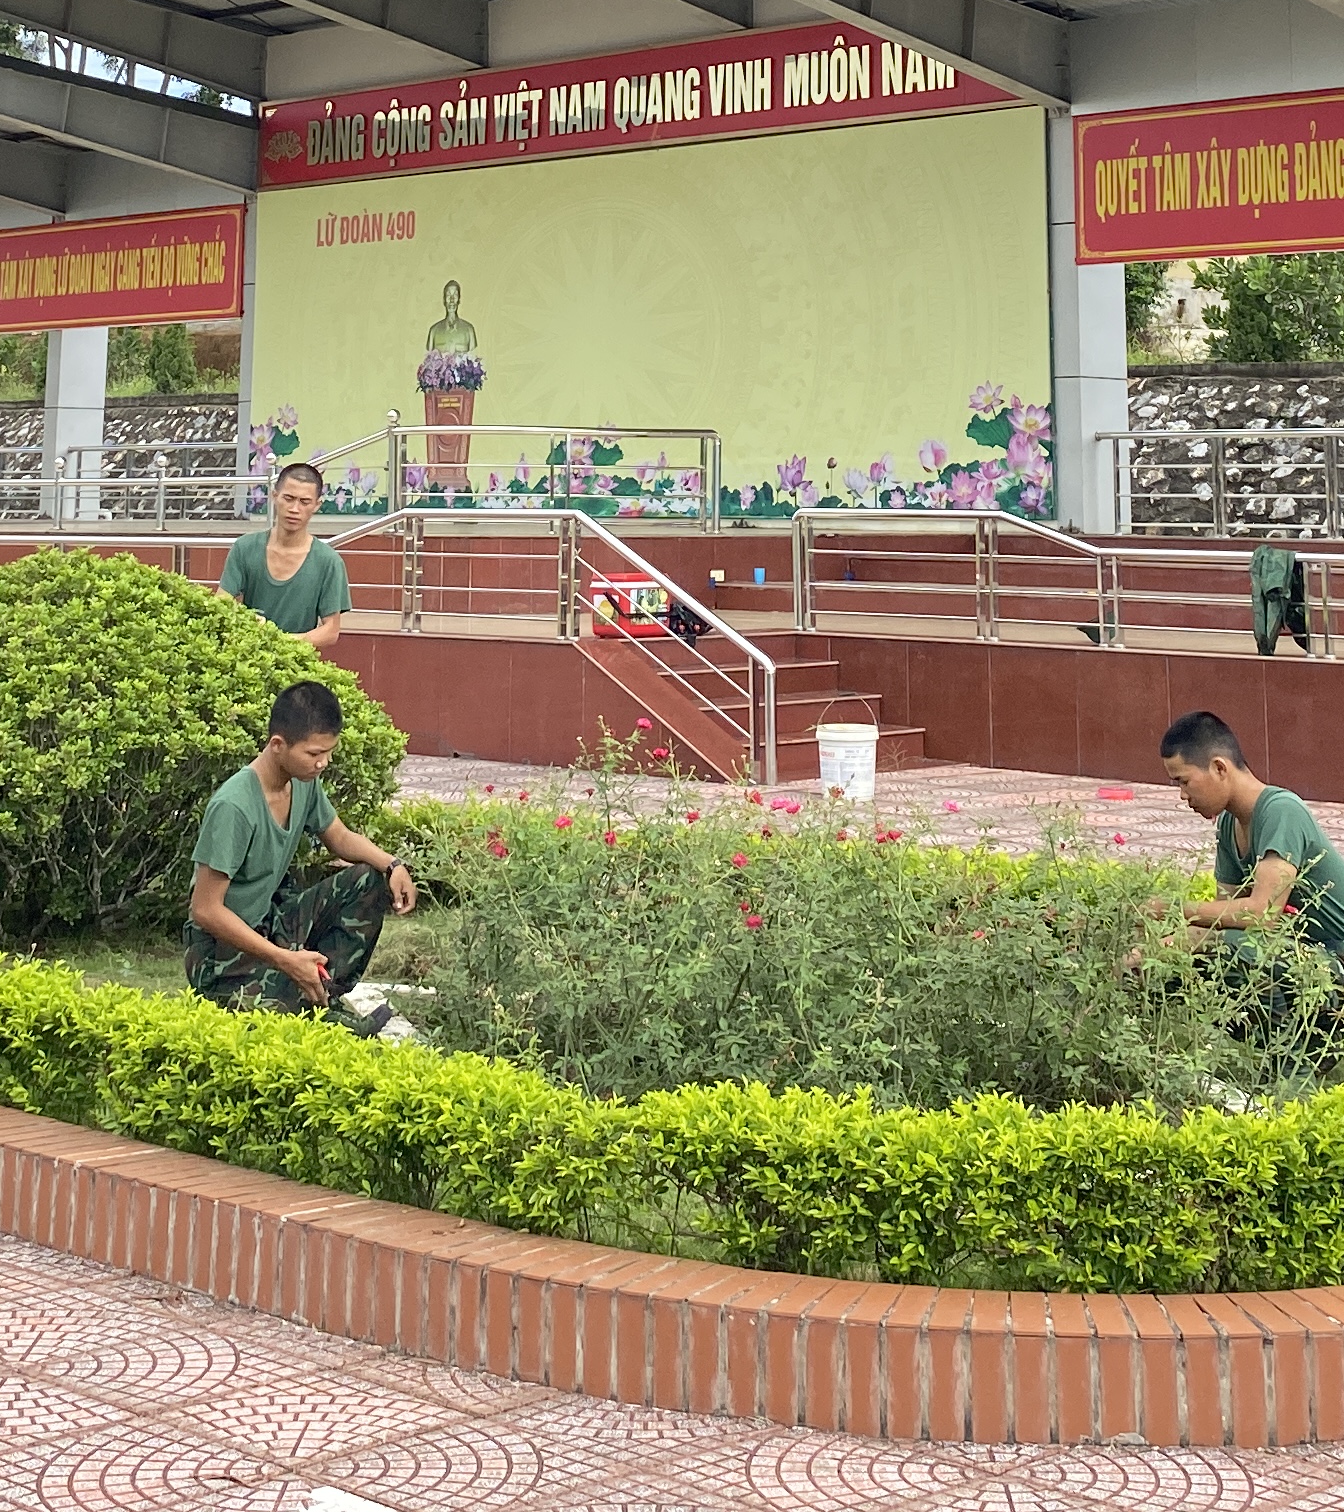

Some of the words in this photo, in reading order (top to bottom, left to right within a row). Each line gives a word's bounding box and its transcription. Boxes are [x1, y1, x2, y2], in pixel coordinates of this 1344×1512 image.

[307, 101, 365, 166] ĐẢNG
[371, 98, 432, 167] CỘNG
[439, 80, 487, 150] SẢN
[493, 80, 543, 151] VIỆT
[549, 80, 606, 136] NAM
[614, 68, 701, 133] QUANG
[708, 57, 771, 117] VINH
[783, 36, 870, 108] MUÔN
[1095, 138, 1148, 223] QUYẾT
[1152, 142, 1191, 212] TÂM
[1196, 137, 1231, 209] XÂY
[1237, 139, 1289, 218] DỰNG
[340, 208, 383, 245] ĐOÀN
[386, 210, 415, 240] 490
